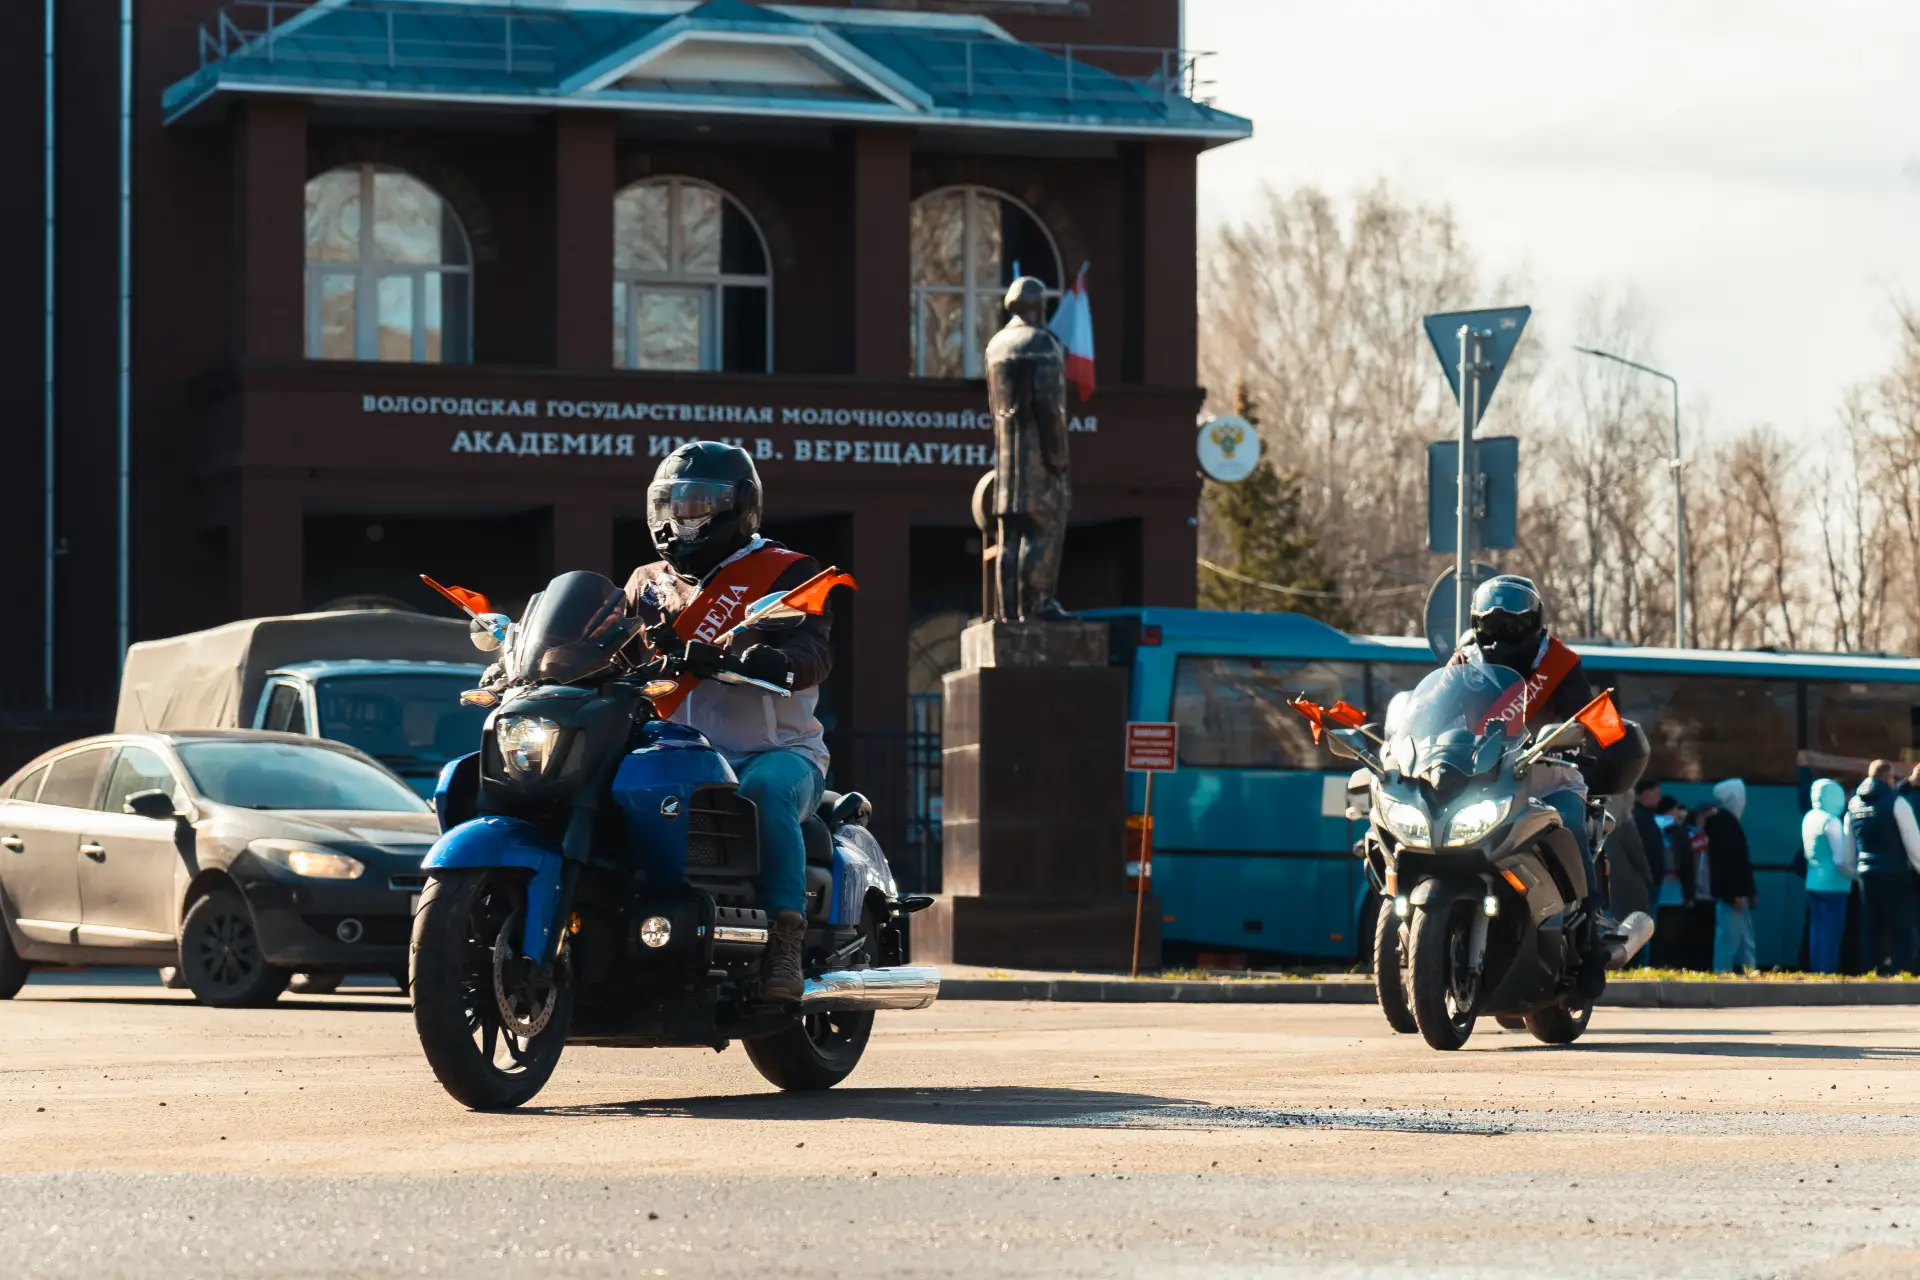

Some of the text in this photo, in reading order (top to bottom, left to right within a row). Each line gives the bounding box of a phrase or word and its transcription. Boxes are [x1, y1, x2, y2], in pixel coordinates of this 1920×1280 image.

[362, 395, 1098, 432] ВОЛОГОДСКАЯ ГОСУДАРСТВЕННАЯ МОЛОЧНОХОЗЯЙСАЯ
[452, 430, 635, 456] АКАДЕМИЯ
[688, 585, 749, 645] БЕДА
[1496, 673, 1548, 720] ОБЕДА
